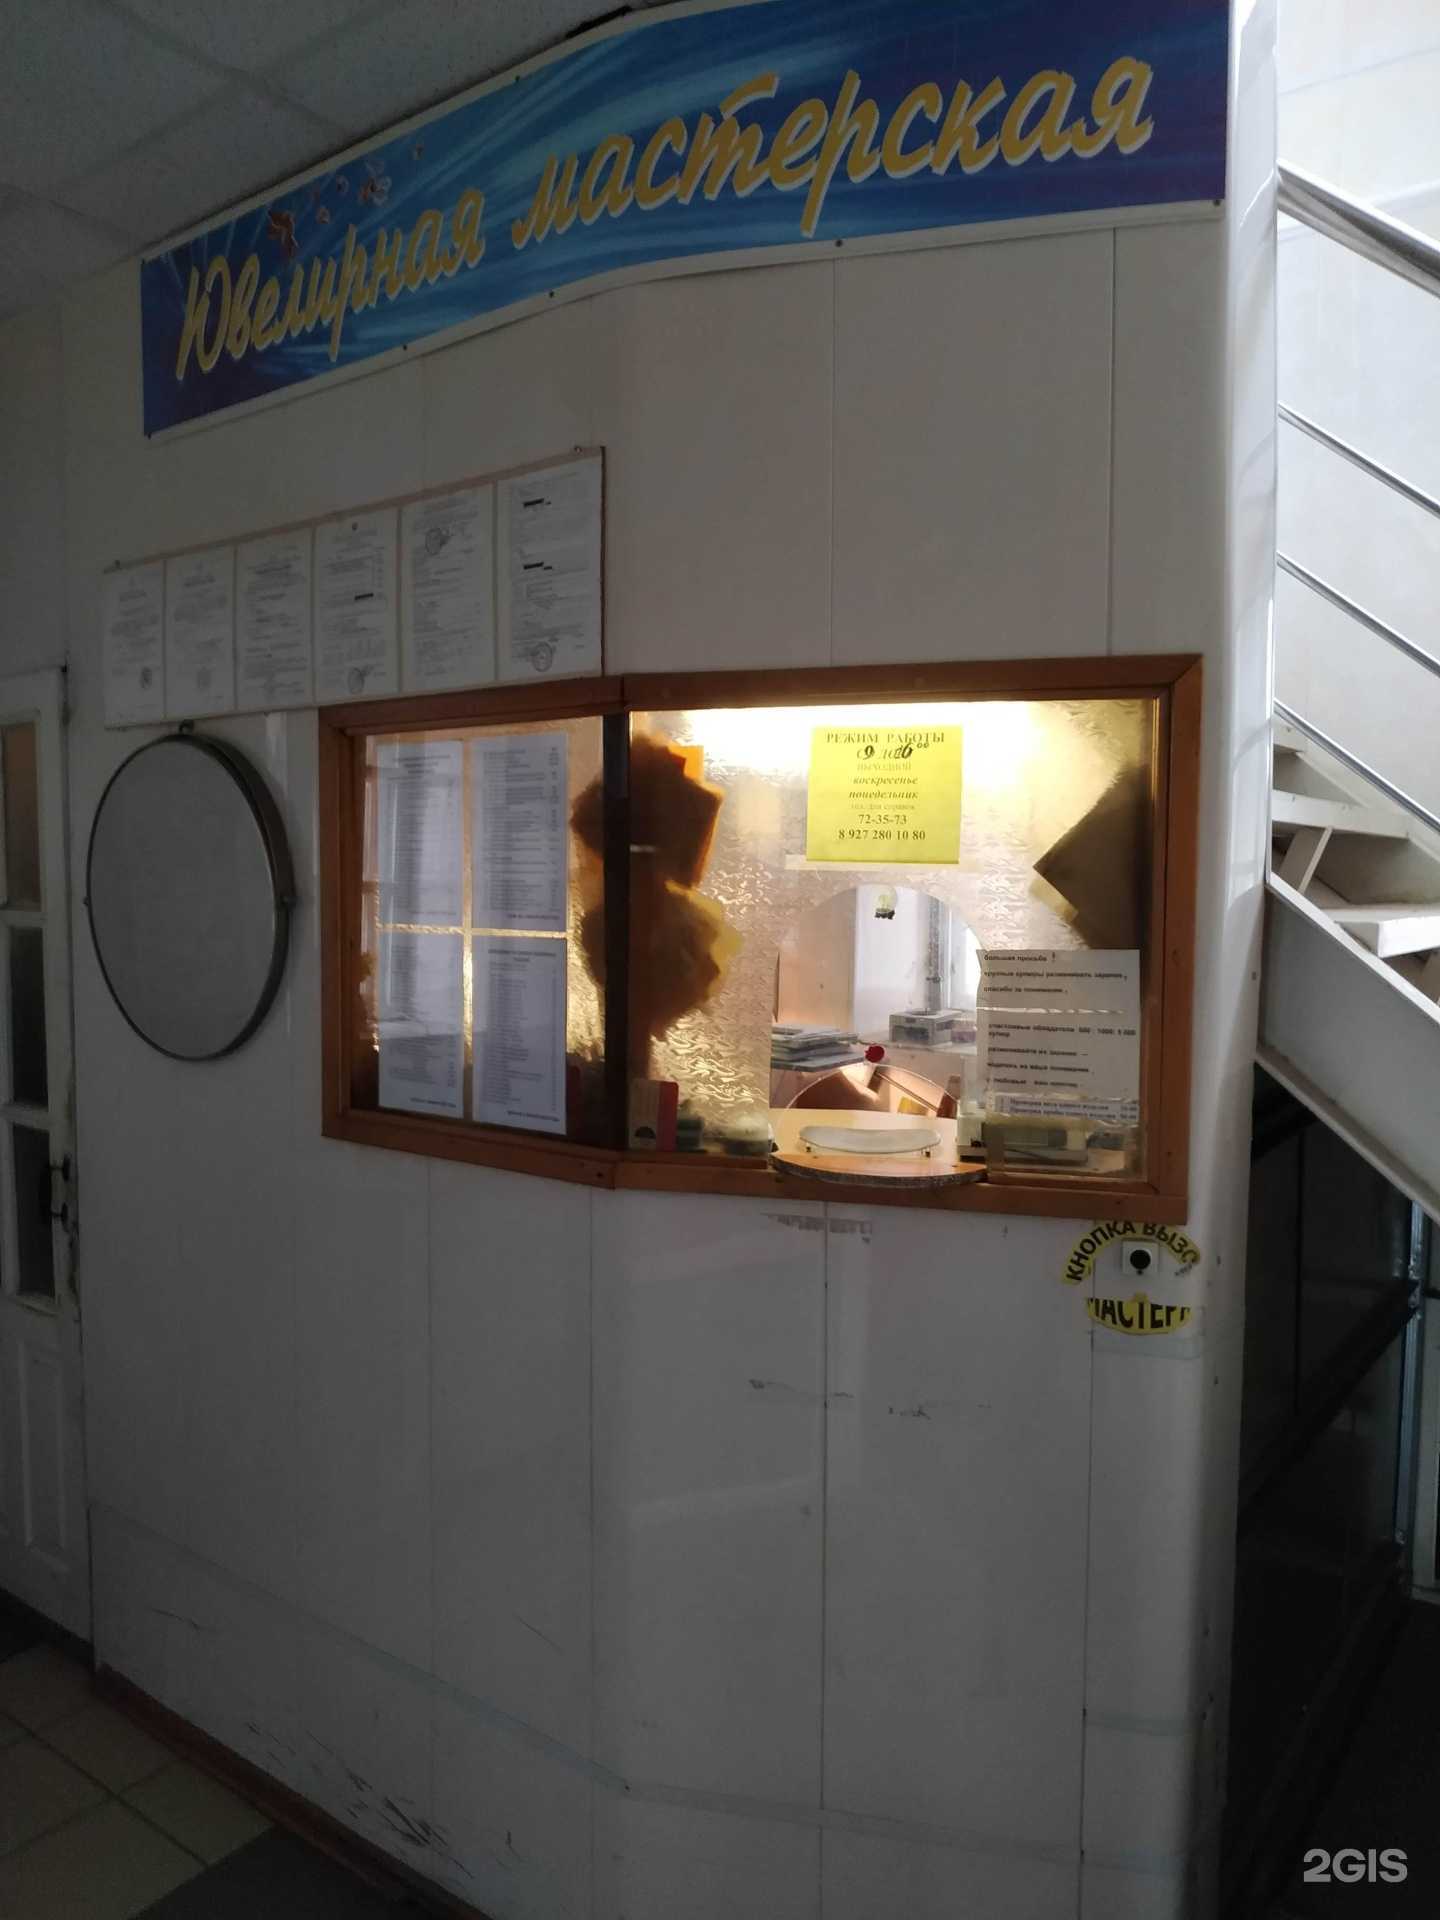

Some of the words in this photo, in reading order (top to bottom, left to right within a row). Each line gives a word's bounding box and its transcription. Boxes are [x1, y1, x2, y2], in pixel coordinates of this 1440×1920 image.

[176, 187, 487, 382] Ювелирная
[511, 56, 1156, 238] мастерская
[826, 732, 879, 744] РЕЖИМ
[887, 732, 945, 744] РАБОТЫ
[853, 776, 918, 787] воскресенье
[849, 790, 919, 800] понедельник
[858, 814, 908, 825] 72-35-73
[838, 829, 846, 840] 8
[848, 829, 869, 840] 927
[872, 829, 892, 840] 280
[896, 830, 909, 841] 10
[912, 830, 926, 841] 80
[1067, 1220, 1137, 1281] КНОПКА
[1142, 1222, 1199, 1276] ВЫЗО
